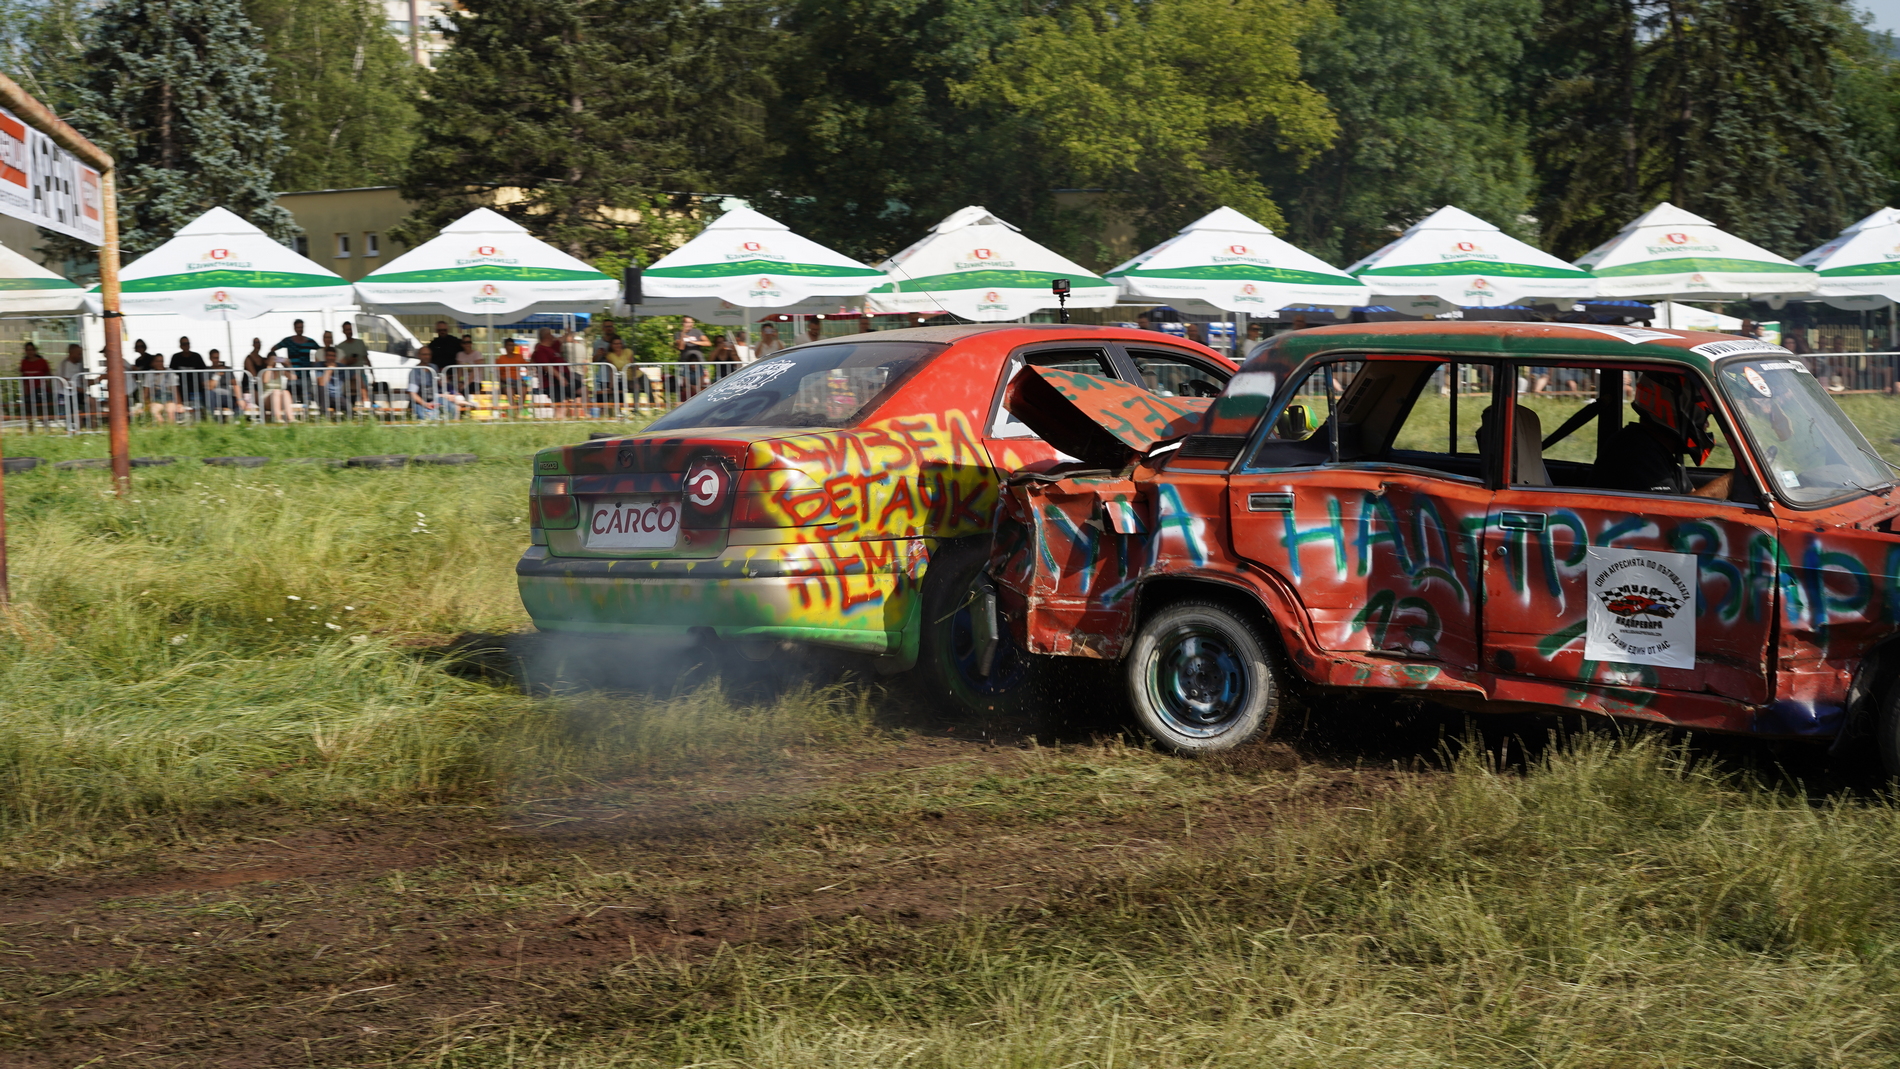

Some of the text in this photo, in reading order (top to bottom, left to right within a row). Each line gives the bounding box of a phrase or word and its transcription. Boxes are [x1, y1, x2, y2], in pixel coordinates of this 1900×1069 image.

[591, 506, 677, 535] CARCO
[1273, 484, 1900, 655] НАДПРВАР
[1656, 640, 1671, 653] НАС
